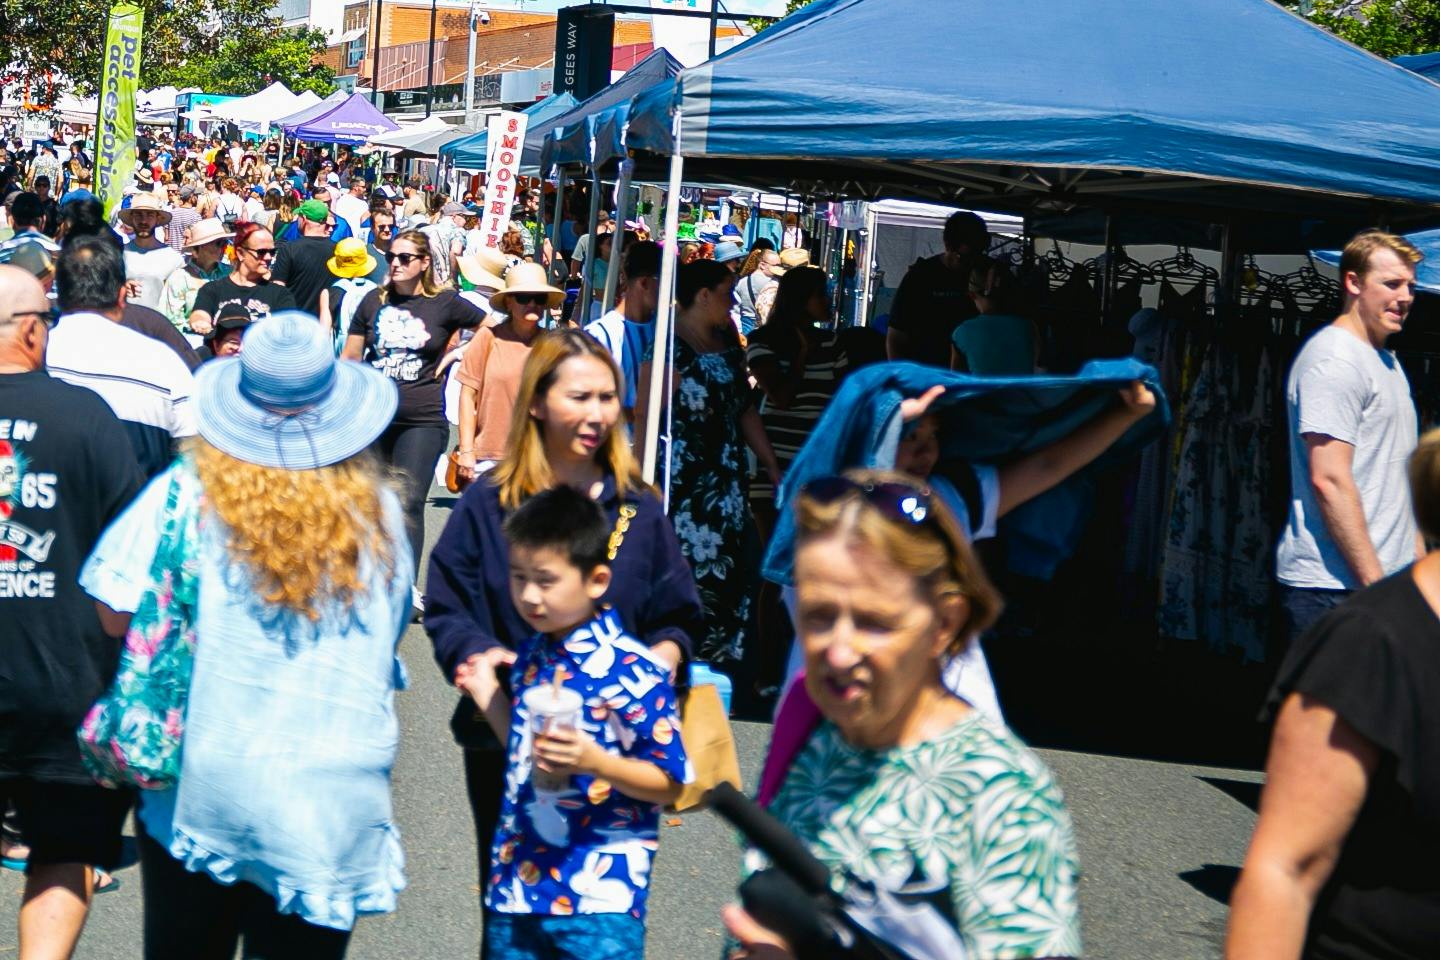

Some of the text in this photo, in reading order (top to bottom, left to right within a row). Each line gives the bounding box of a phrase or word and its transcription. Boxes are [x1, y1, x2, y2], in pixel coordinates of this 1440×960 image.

[567, 22, 577, 49] WAY
[121, 32, 138, 81] pet
[565, 53, 576, 85] GEES
[484, 118, 519, 249] SMOOTHIE
[13, 419, 38, 442] IN
[21, 473, 58, 509] 65
